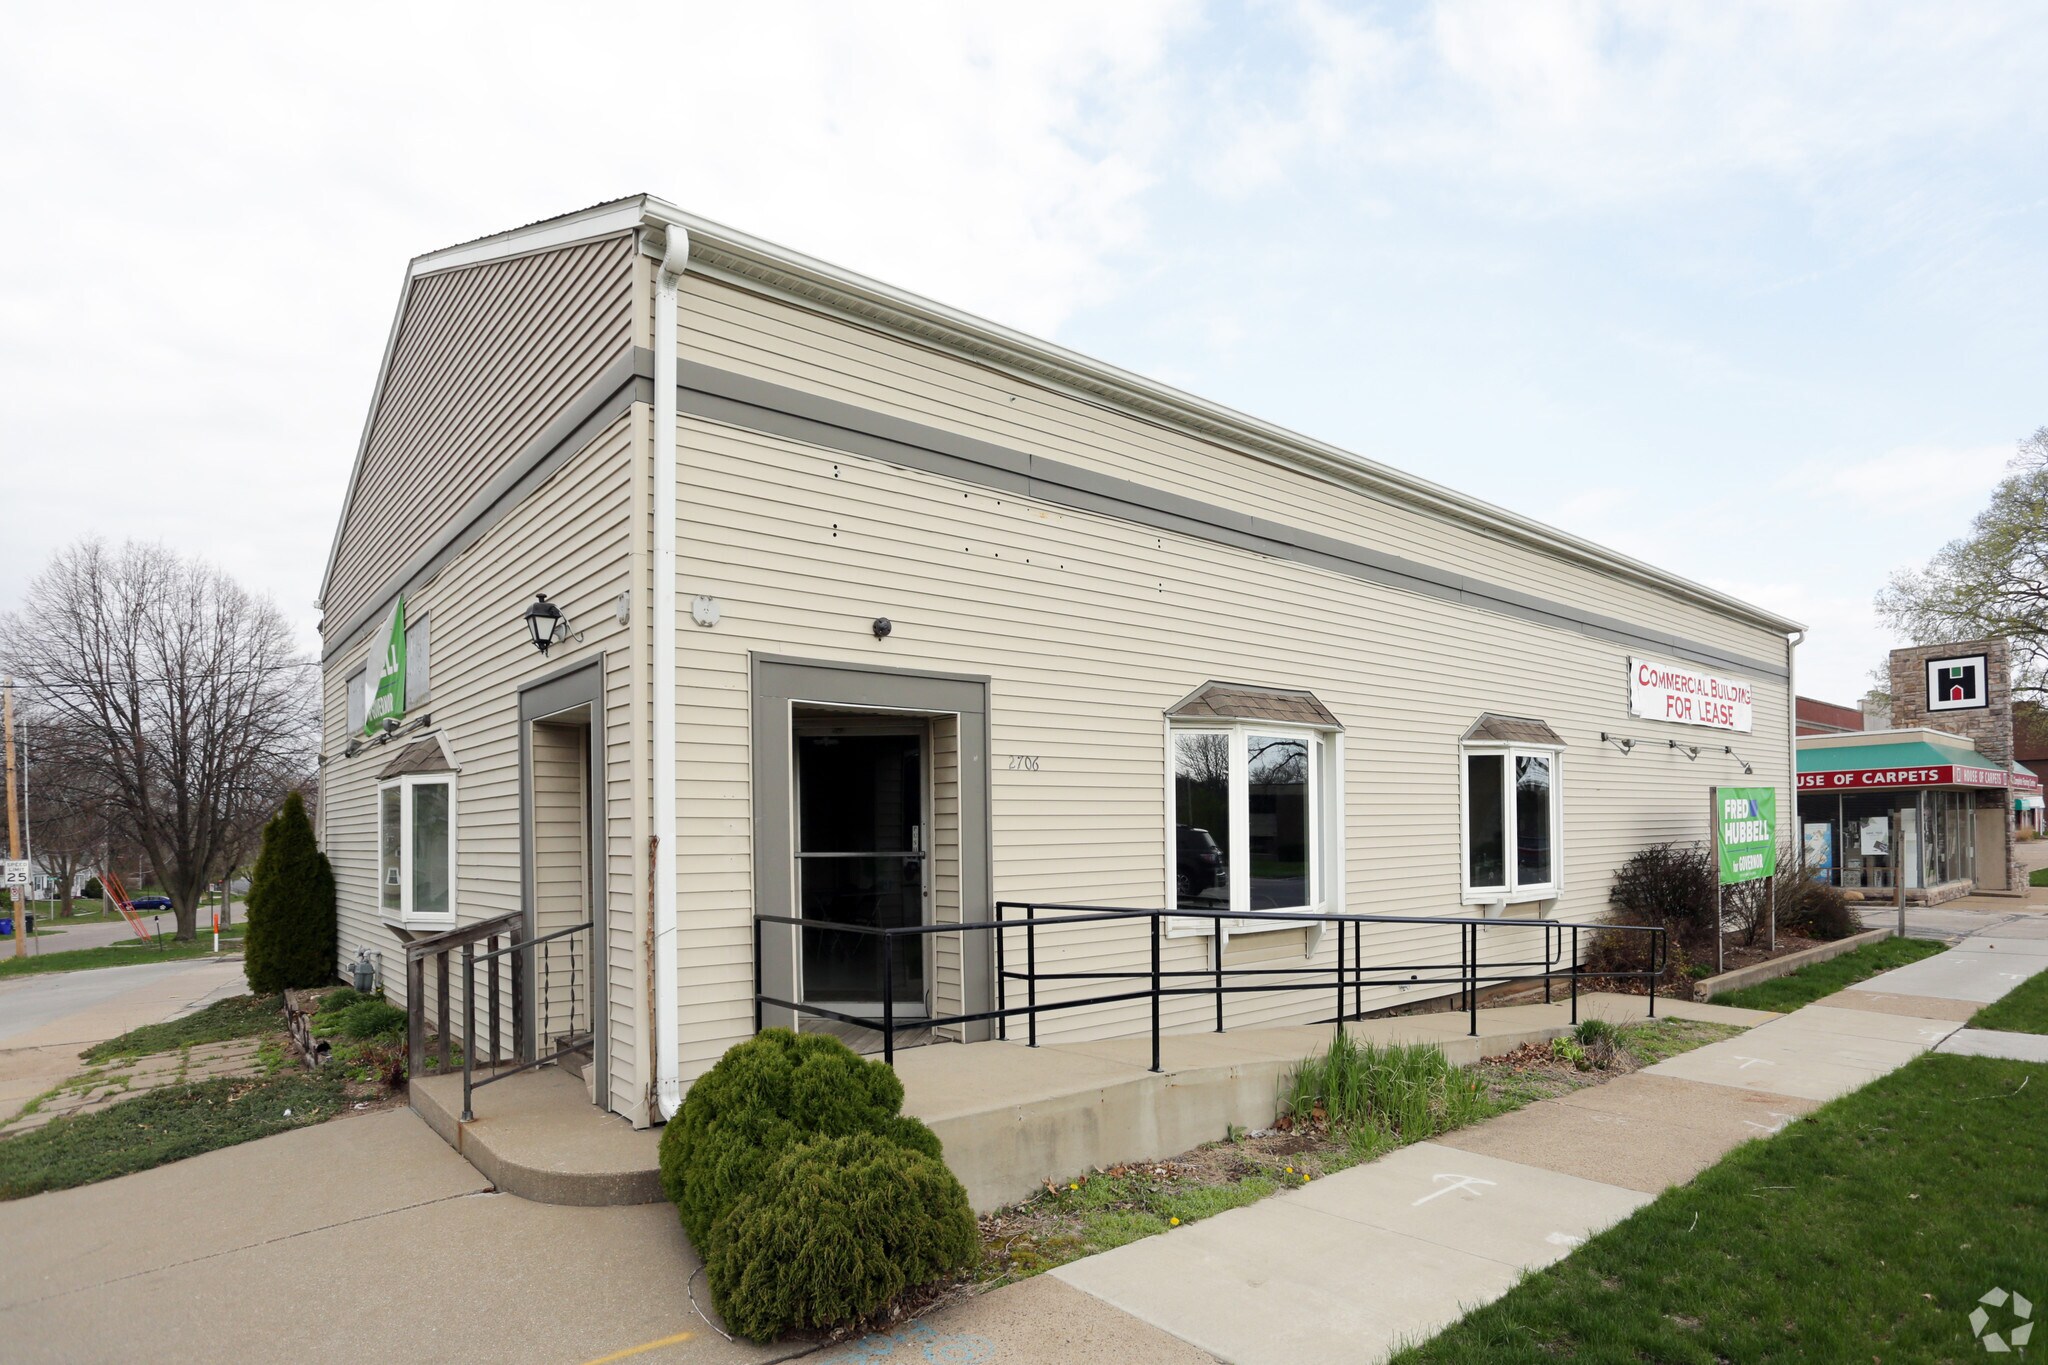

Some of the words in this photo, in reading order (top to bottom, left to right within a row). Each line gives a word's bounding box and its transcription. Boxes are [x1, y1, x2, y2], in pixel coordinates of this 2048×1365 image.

[1638, 664, 1709, 697] COMMERCIAL
[1710, 679, 1751, 705] BUILDING
[1666, 695, 1692, 720] FOR
[1698, 700, 1734, 726] LEASE
[1008, 755, 1039, 772] 2706
[1833, 773, 1854, 785] OF
[1861, 769, 1939, 784] CARPETS
[1963, 769, 1978, 783] HOUSE
[1985, 771, 2002, 785] CARPETS
[1724, 799, 1749, 820] FRED
[1724, 820, 1769, 845] HUBBELL
[7, 872, 27, 882] 25
